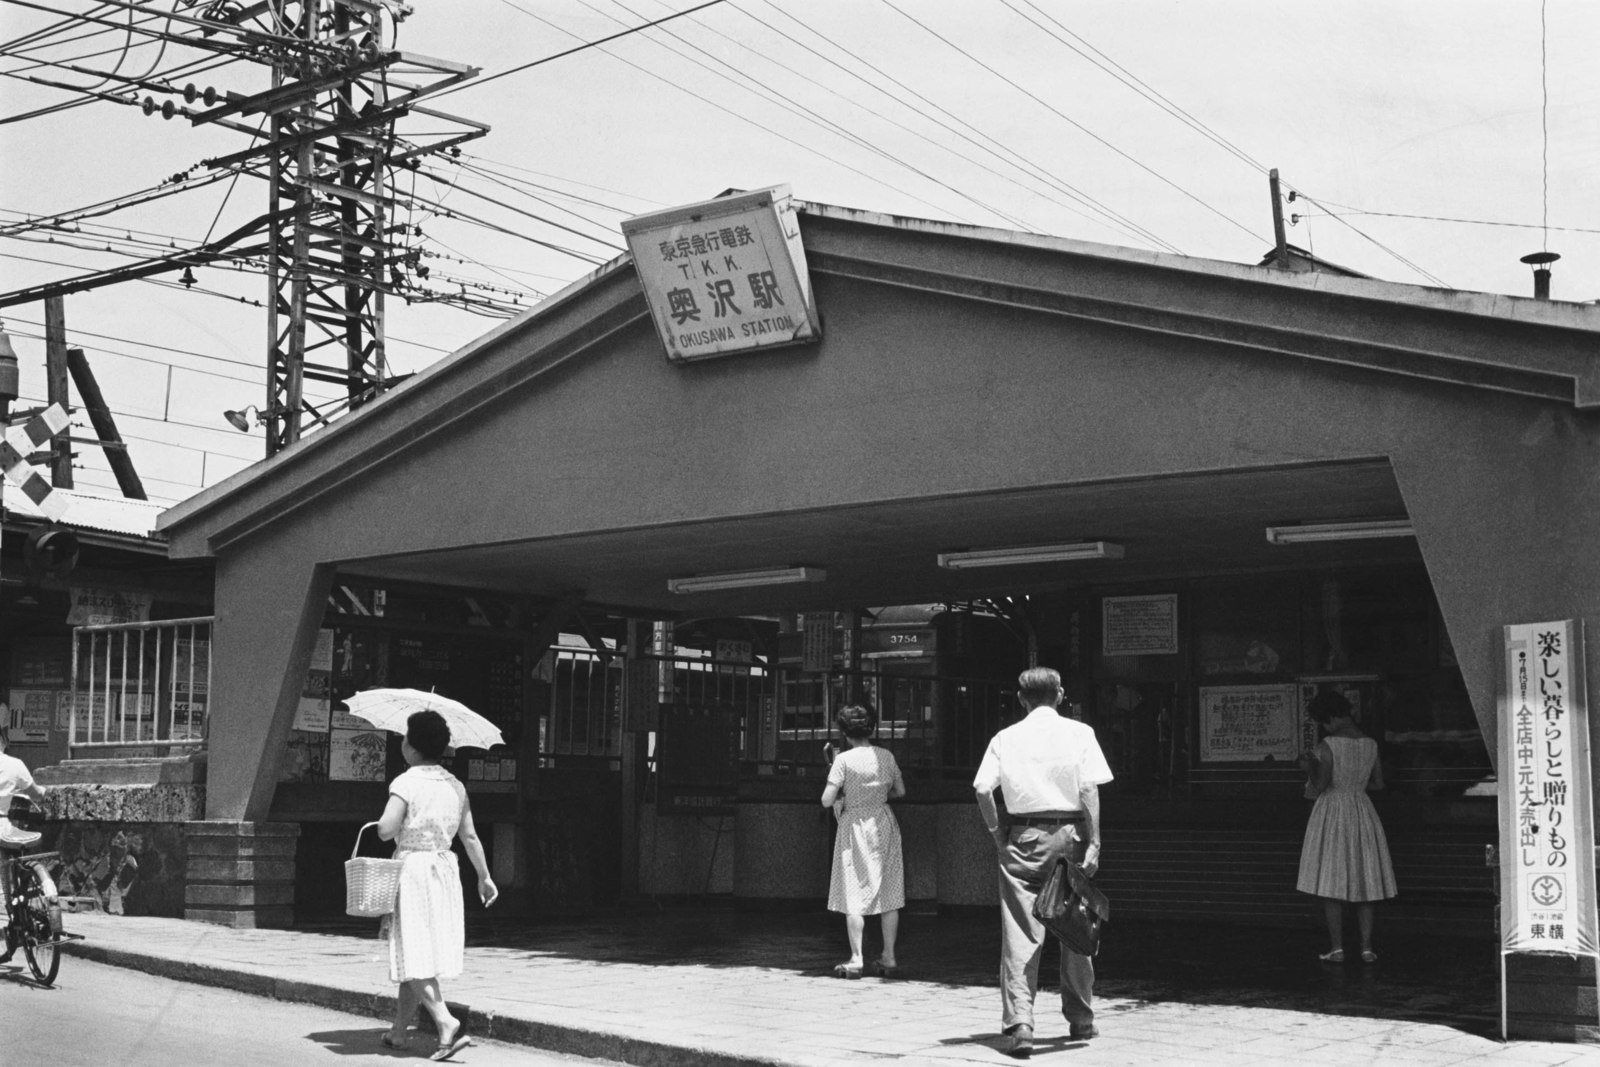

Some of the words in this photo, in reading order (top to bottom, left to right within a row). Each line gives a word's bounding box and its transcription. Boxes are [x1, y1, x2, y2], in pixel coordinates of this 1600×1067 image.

[659, 225, 755, 262] 東京急行電鉄
[666, 269, 785, 326] 奥沢駅
[679, 326, 736, 349] OKUSAWA
[741, 315, 794, 337] STATION
[889, 634, 918, 644] 3754
[1538, 631, 1567, 868] 楽しい暮らしと贈りもの
[1517, 704, 1536, 867] 全店中元大売出し
[1530, 923, 1565, 940] 東横
